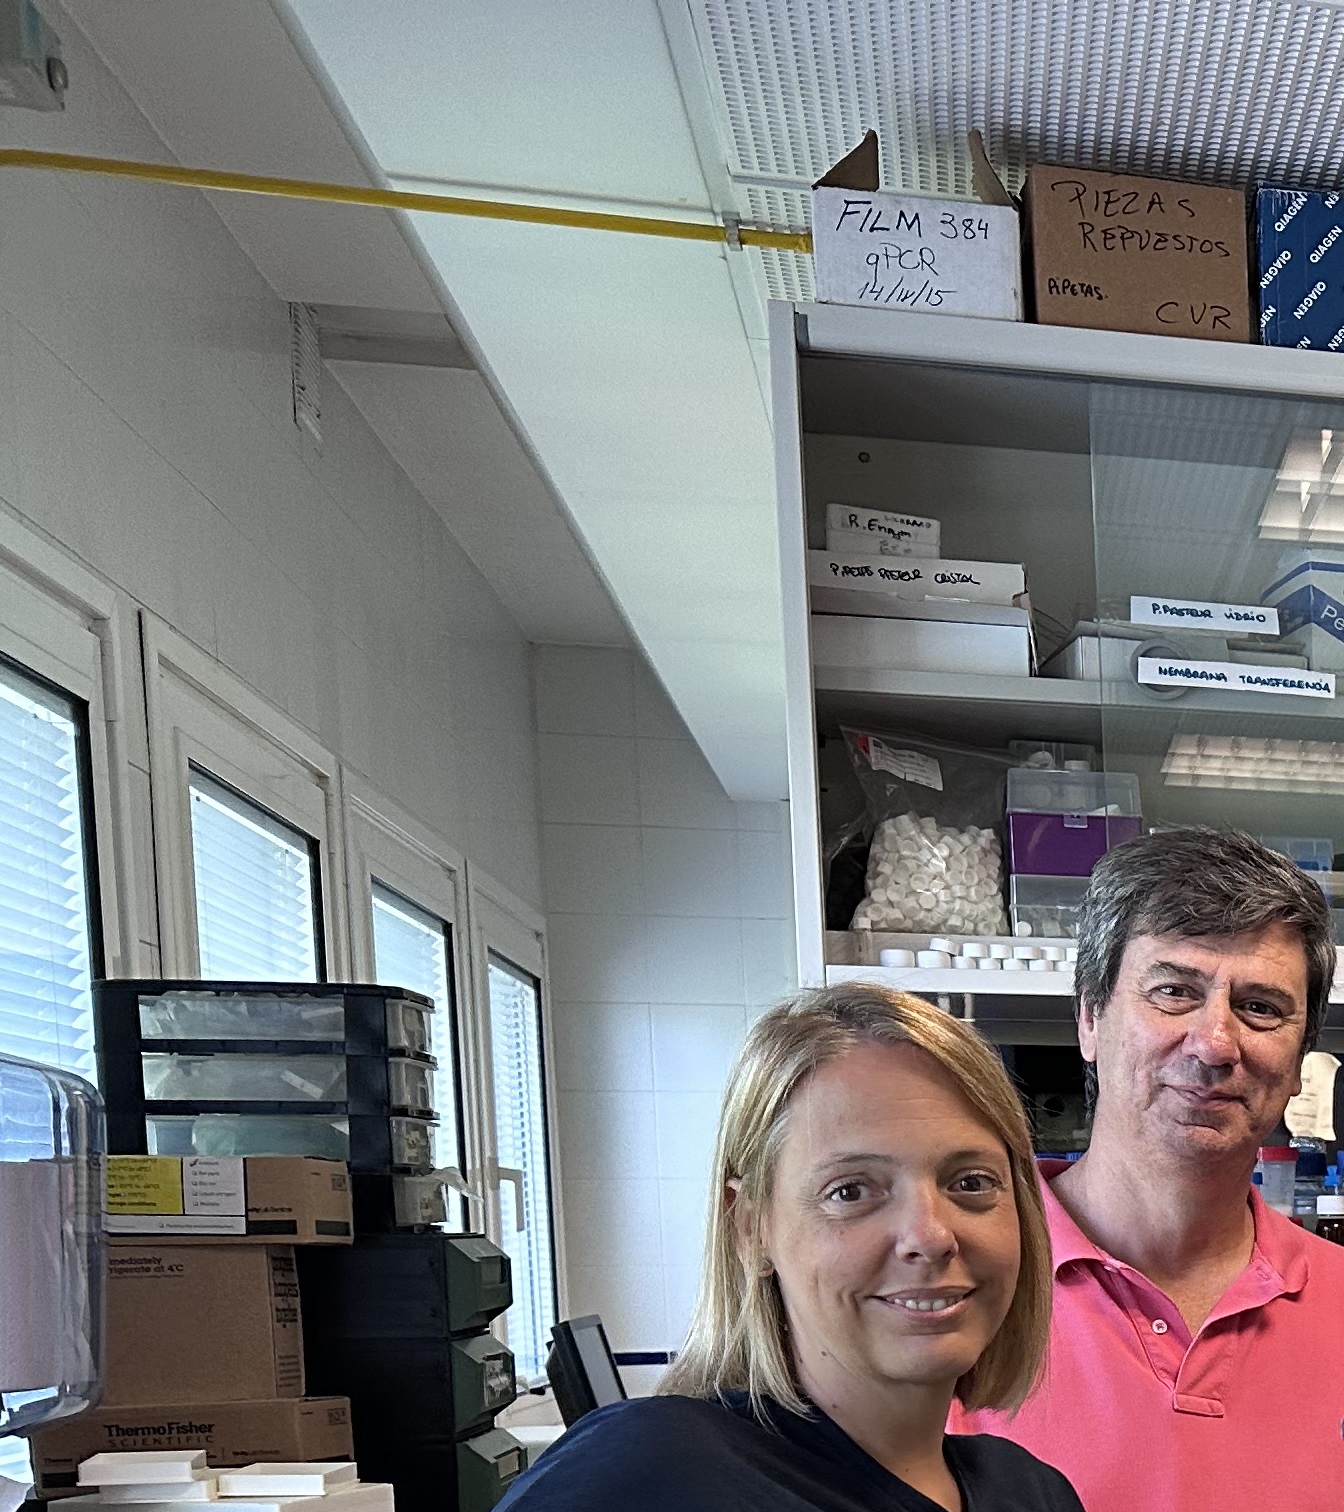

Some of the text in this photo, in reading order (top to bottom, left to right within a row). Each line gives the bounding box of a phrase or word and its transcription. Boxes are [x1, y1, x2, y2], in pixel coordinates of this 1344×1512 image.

[1051, 181, 1195, 218] PIEZAS
[836, 200, 988, 239] FILM 384
[1078, 222, 1230, 257] REPUESTOS
[1309, 225, 1342, 263] QIAGEN
[1260, 250, 1291, 288] QIAGEN
[1156, 302, 1230, 329] CVR
[1293, 281, 1327, 320] QIAGEN
[104, 1422, 214, 1437] ThermoFisher
[108, 1435, 214, 1447] SCIENTIFIC
